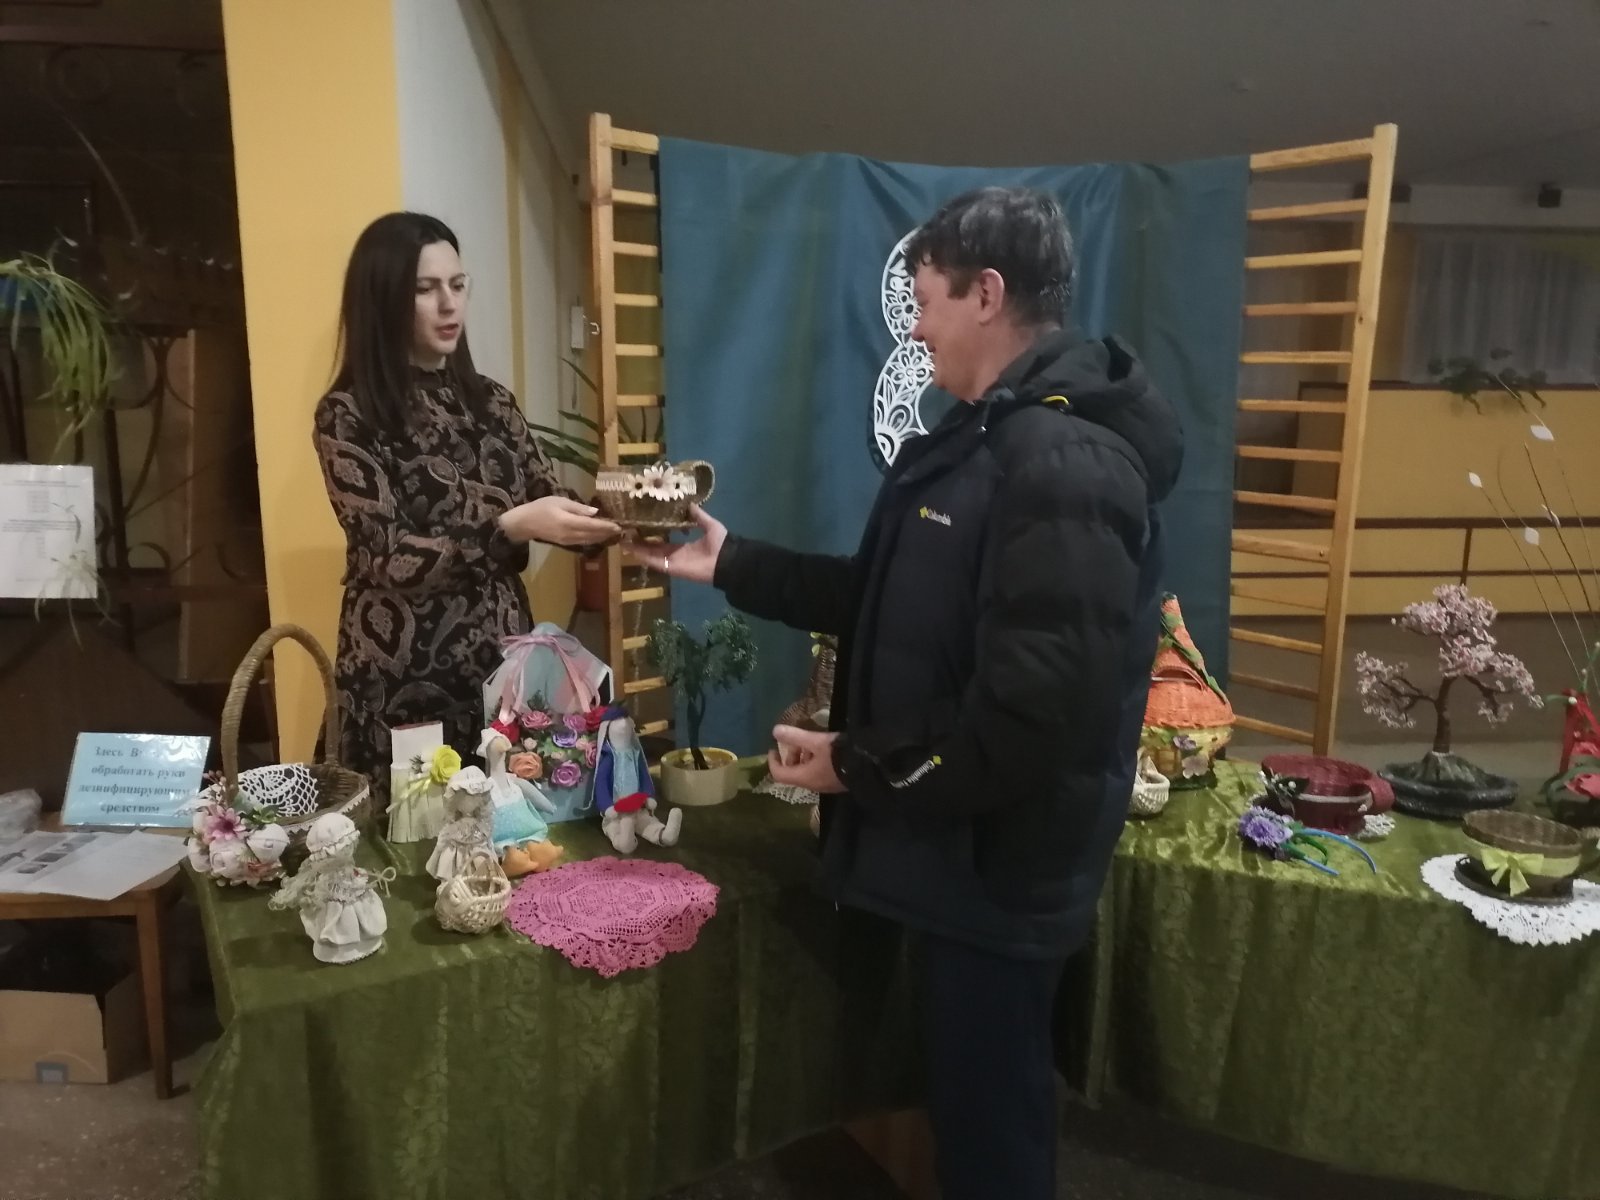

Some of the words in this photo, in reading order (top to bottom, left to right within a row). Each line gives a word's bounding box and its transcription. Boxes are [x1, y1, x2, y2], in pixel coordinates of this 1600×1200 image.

[91, 765, 154, 776] обработать
[157, 768, 186, 779] руки
[100, 804, 160, 814] средством
